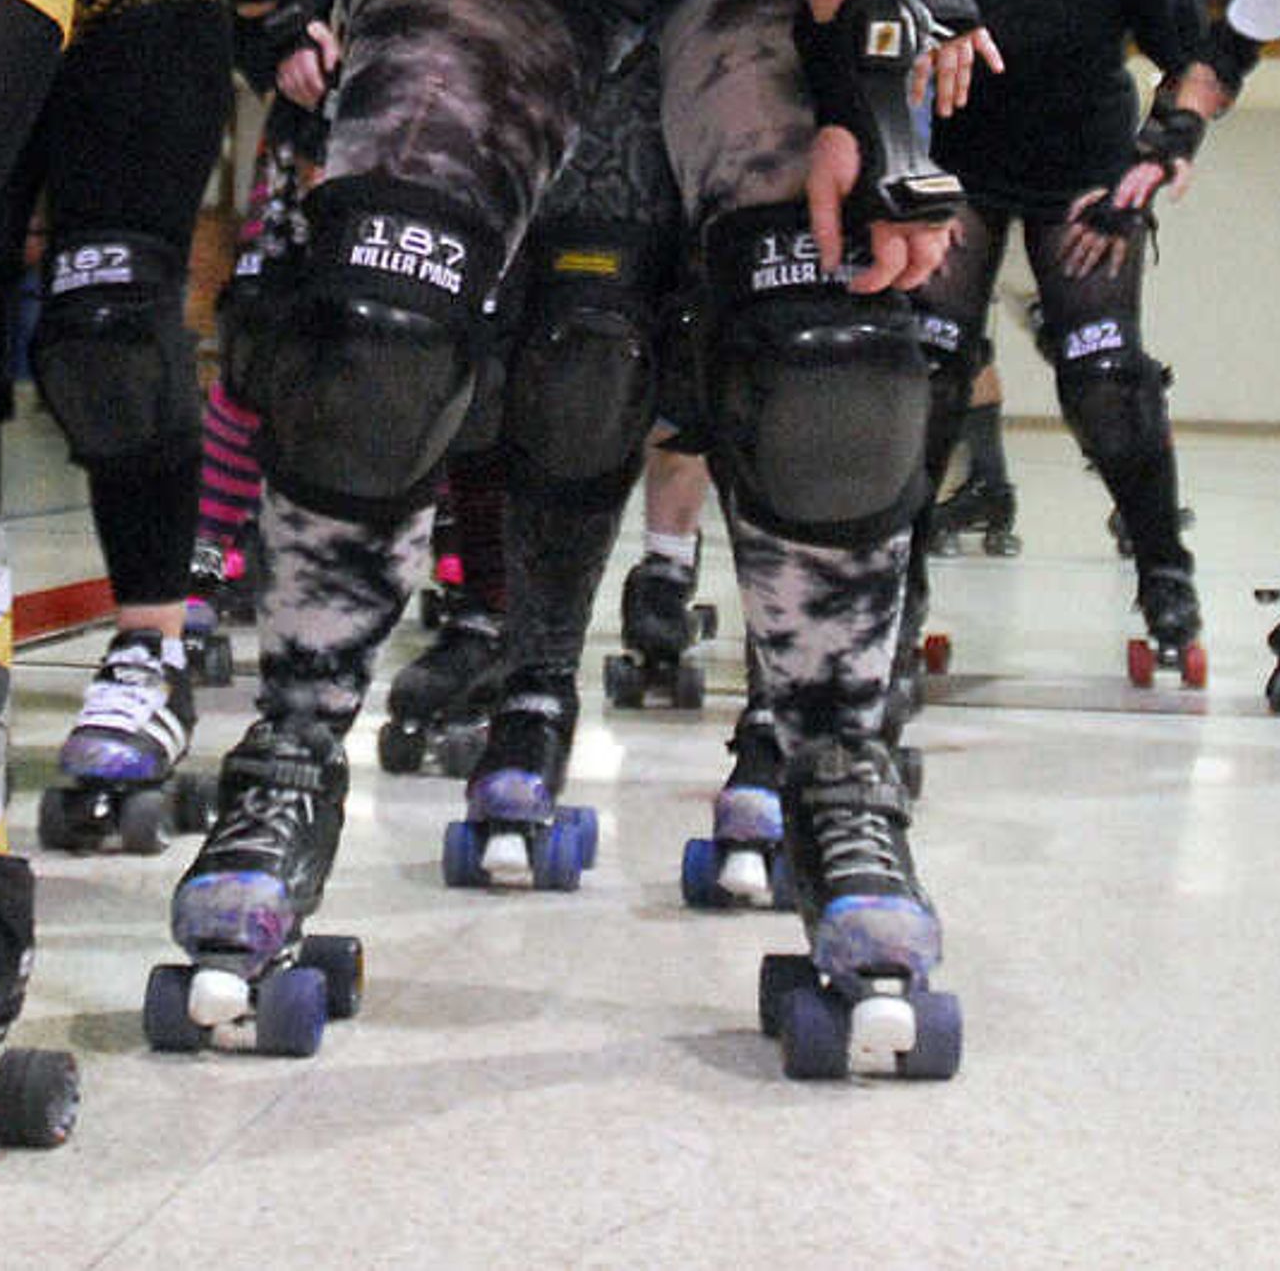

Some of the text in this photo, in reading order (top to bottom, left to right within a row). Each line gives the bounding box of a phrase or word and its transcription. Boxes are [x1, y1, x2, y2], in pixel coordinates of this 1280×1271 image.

[57, 245, 129, 274] 187
[364, 216, 465, 267] 187
[349, 245, 463, 294] KILLER PADS
[753, 262, 817, 291] KILLER
